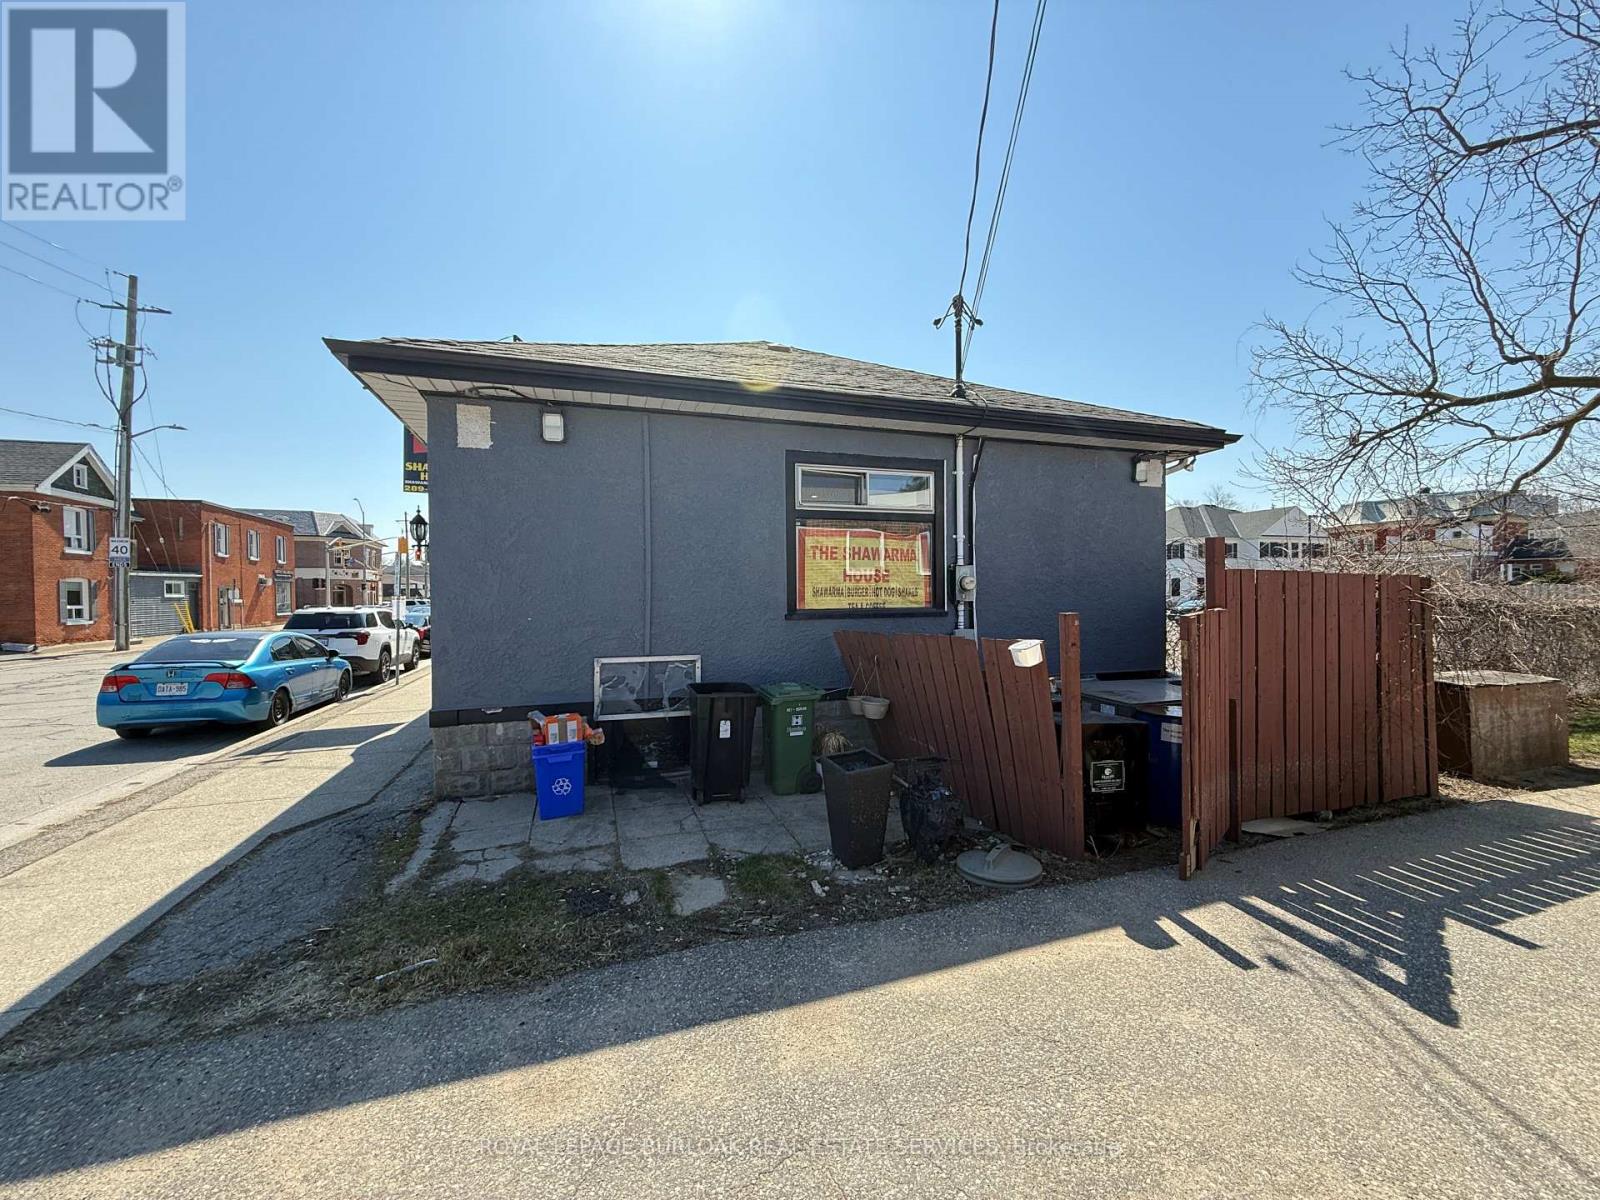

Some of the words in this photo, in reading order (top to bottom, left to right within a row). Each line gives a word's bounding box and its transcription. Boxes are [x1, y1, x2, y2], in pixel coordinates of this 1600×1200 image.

[111, 545, 128, 555] 40
[810, 546, 838, 560] THE
[843, 547, 917, 562] SHAWARMA
[843, 569, 890, 583] HOUSE
